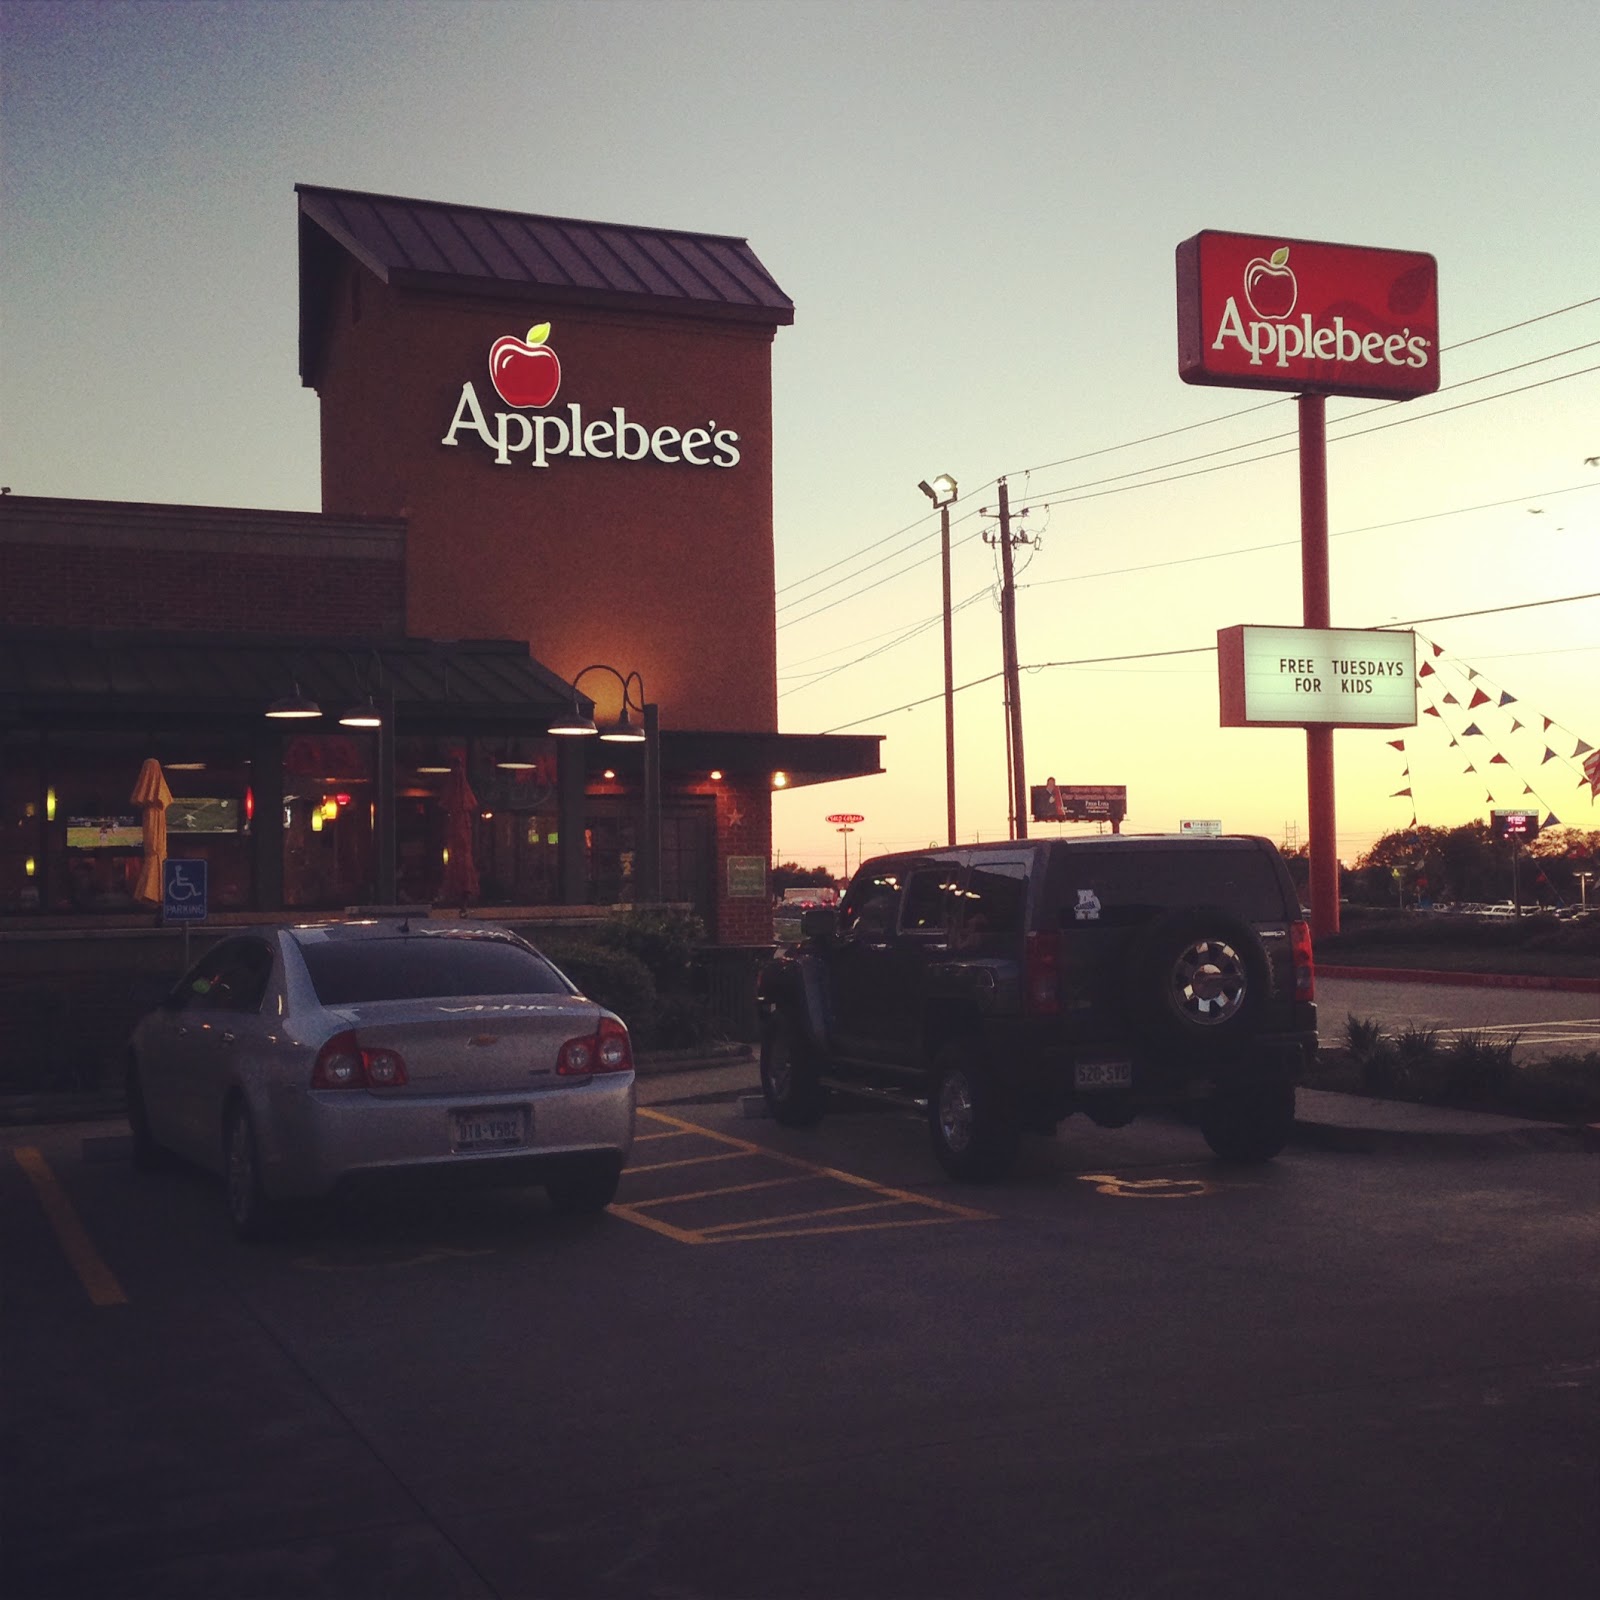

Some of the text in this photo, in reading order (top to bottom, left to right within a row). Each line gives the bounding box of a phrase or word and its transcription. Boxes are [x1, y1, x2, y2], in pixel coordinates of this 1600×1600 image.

[1212, 296, 1429, 368] Applebee's
[441, 381, 741, 467] Applebee's
[1280, 658, 1404, 676] FREE TUESDAYS
[1295, 678, 1373, 693] FOR KIDS
[166, 904, 204, 915] PARKING
